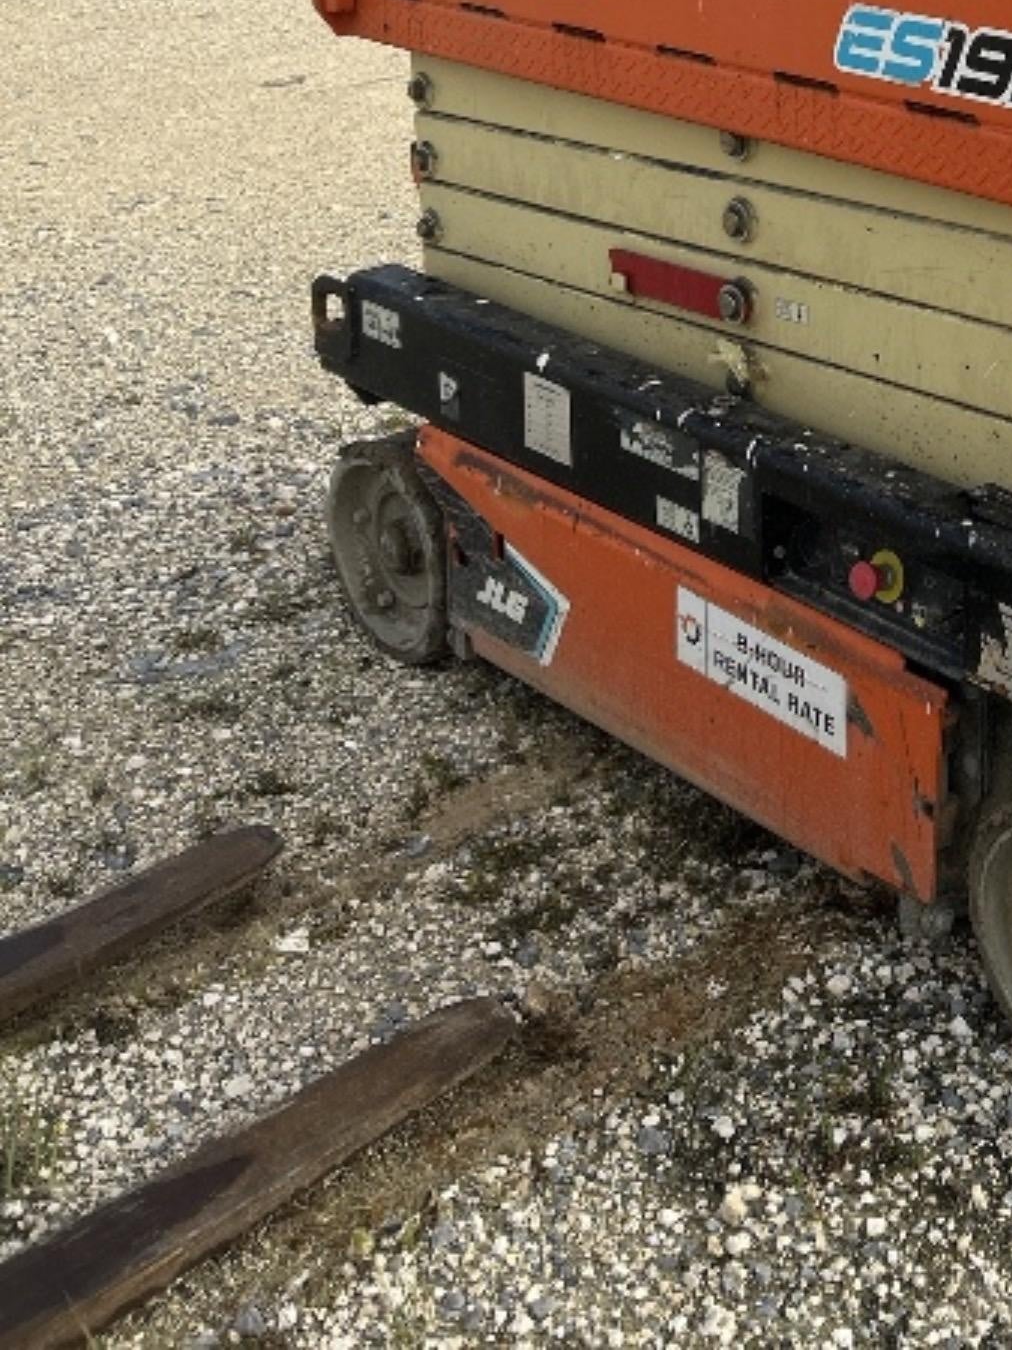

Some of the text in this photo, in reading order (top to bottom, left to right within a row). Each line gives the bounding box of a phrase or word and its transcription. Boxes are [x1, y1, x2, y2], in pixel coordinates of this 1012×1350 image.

[476, 575, 529, 625] JLG
[713, 650, 835, 736] RENTAL RATE
